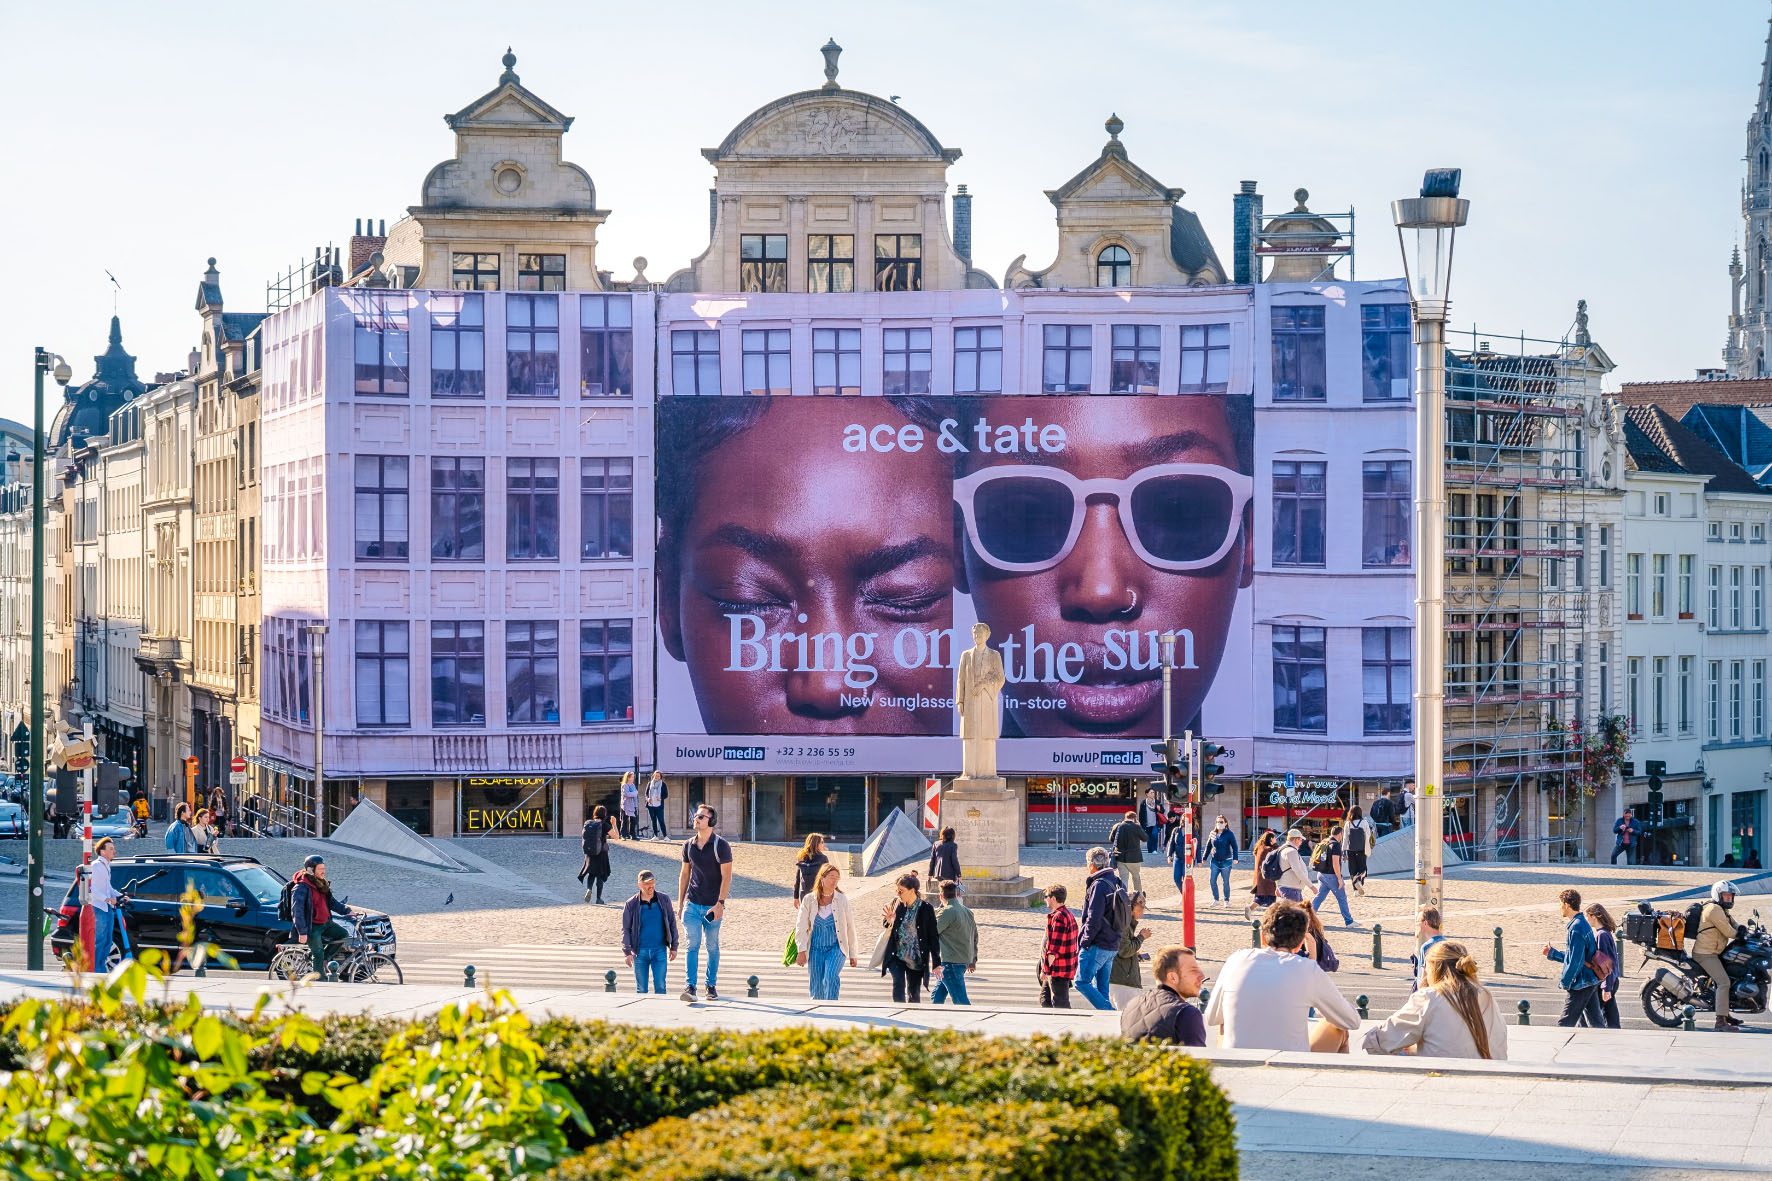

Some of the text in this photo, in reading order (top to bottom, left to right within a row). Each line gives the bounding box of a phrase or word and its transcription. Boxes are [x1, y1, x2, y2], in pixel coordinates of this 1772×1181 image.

[842, 417, 1066, 453] ace & tate
[723, 612, 1200, 689] Bring on the sun
[840, 693, 1067, 711] New sunglasse in-store
[776, 747, 855, 757] +32 3 236 55 59
[514, 777, 545, 785] ROOM
[1046, 780, 1105, 795] shp&go
[1302, 791, 1337, 804] Mood
[469, 809, 544, 829] ENYGMA
